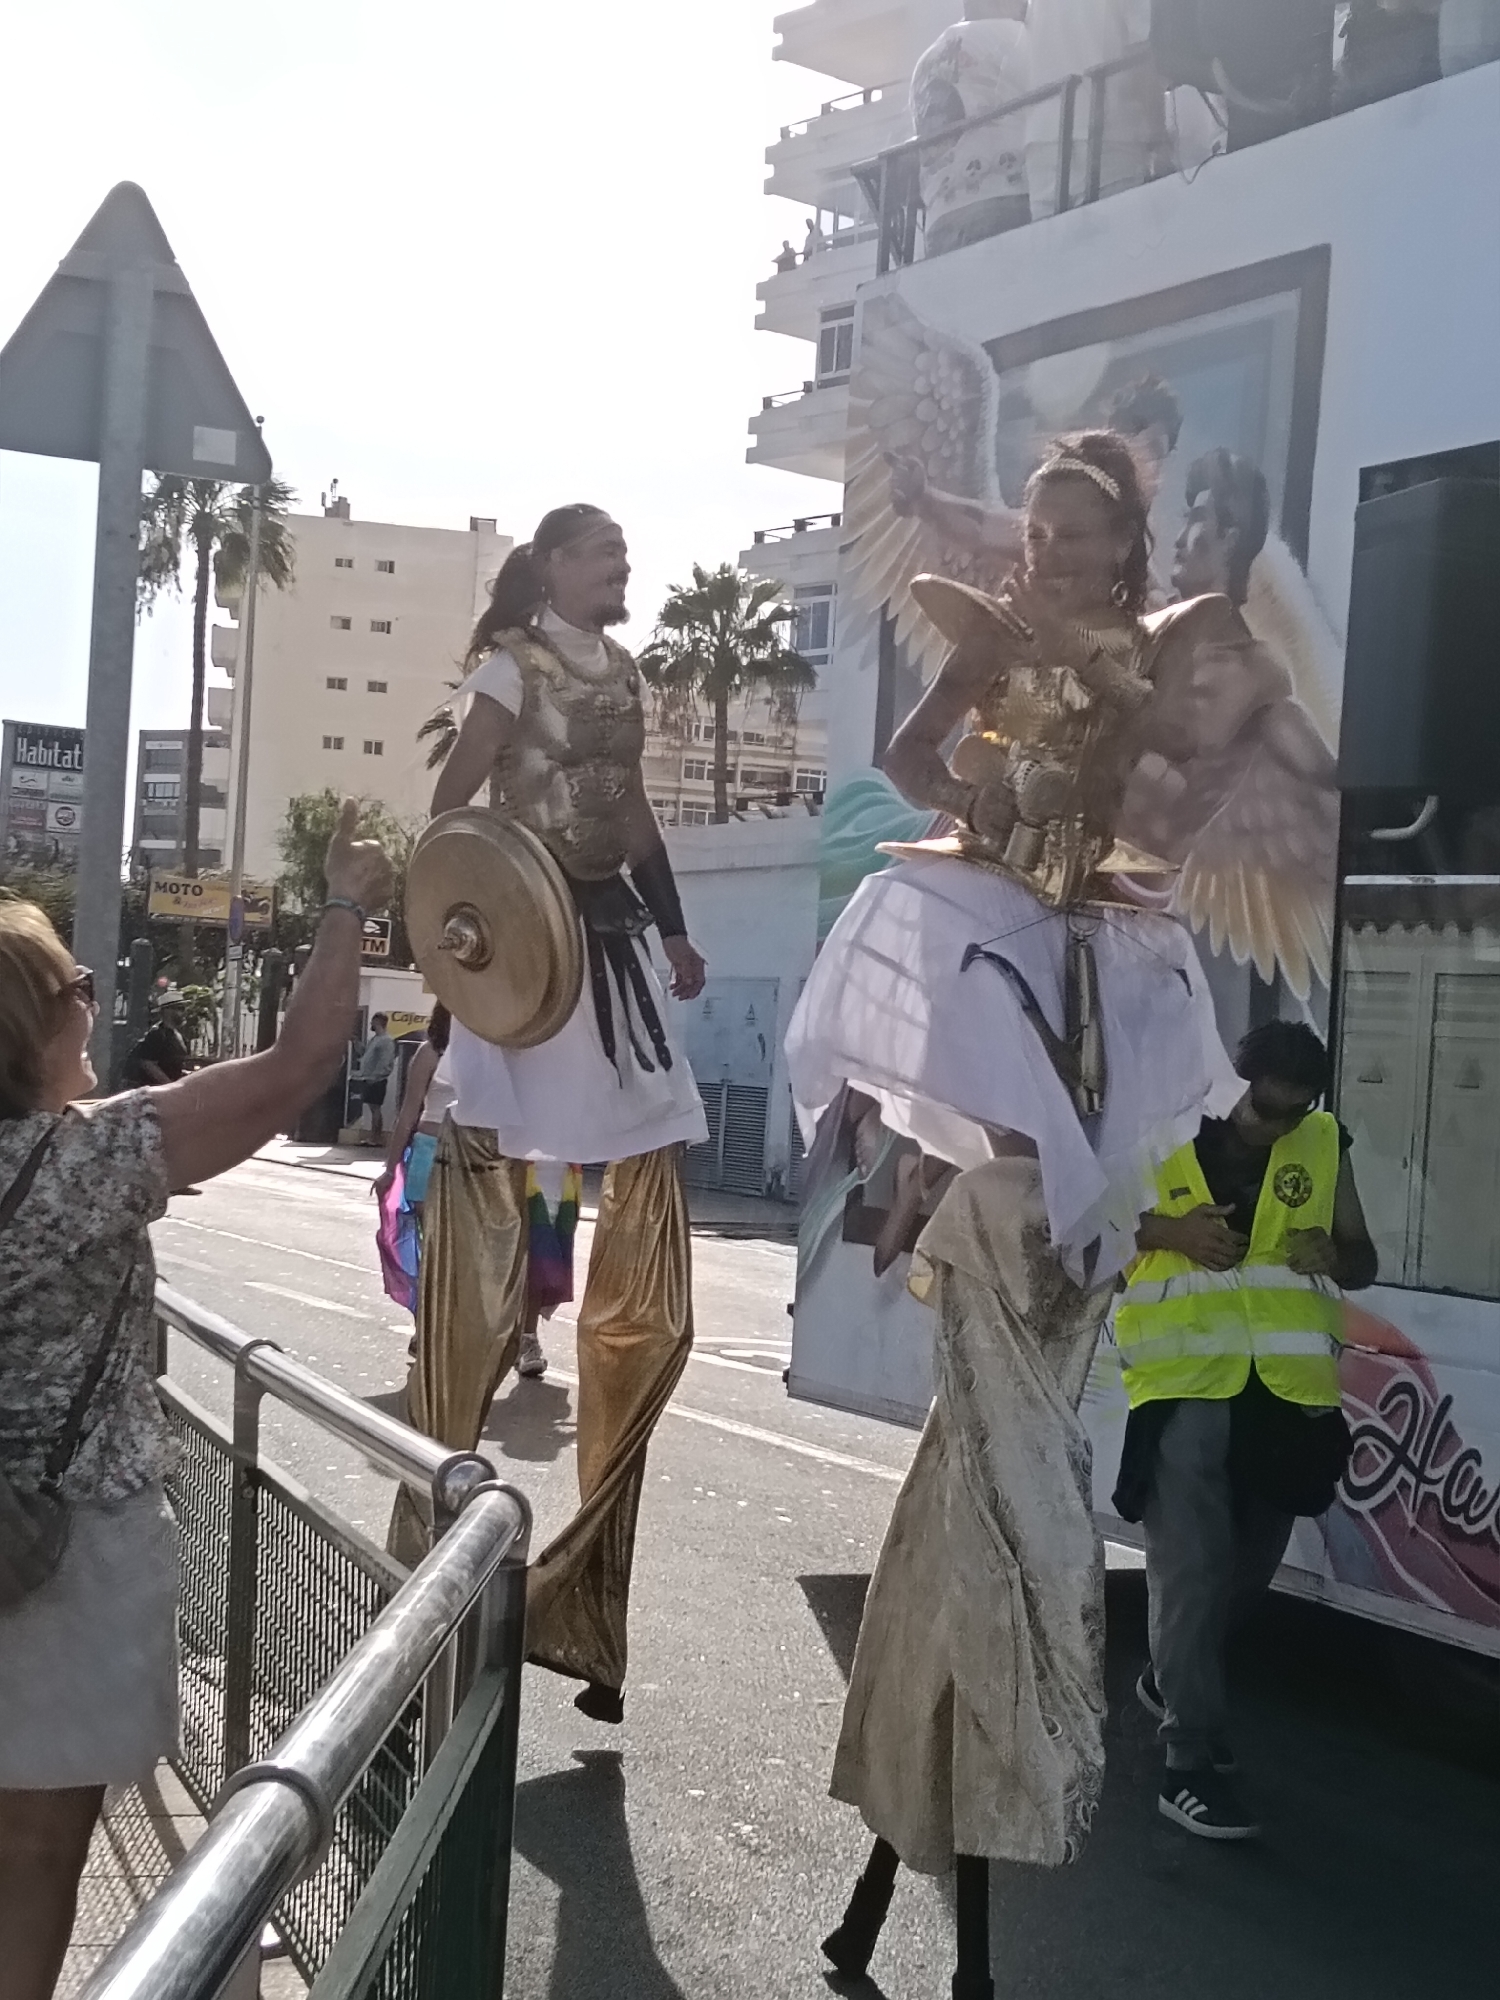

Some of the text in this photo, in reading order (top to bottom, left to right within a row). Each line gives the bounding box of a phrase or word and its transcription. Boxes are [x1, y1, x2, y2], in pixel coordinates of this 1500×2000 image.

[16, 736, 82, 770] Habitat
[154, 881, 203, 896] MOTO
[362, 938, 386, 954] TM
[1340, 1378, 1500, 1534] Ha
